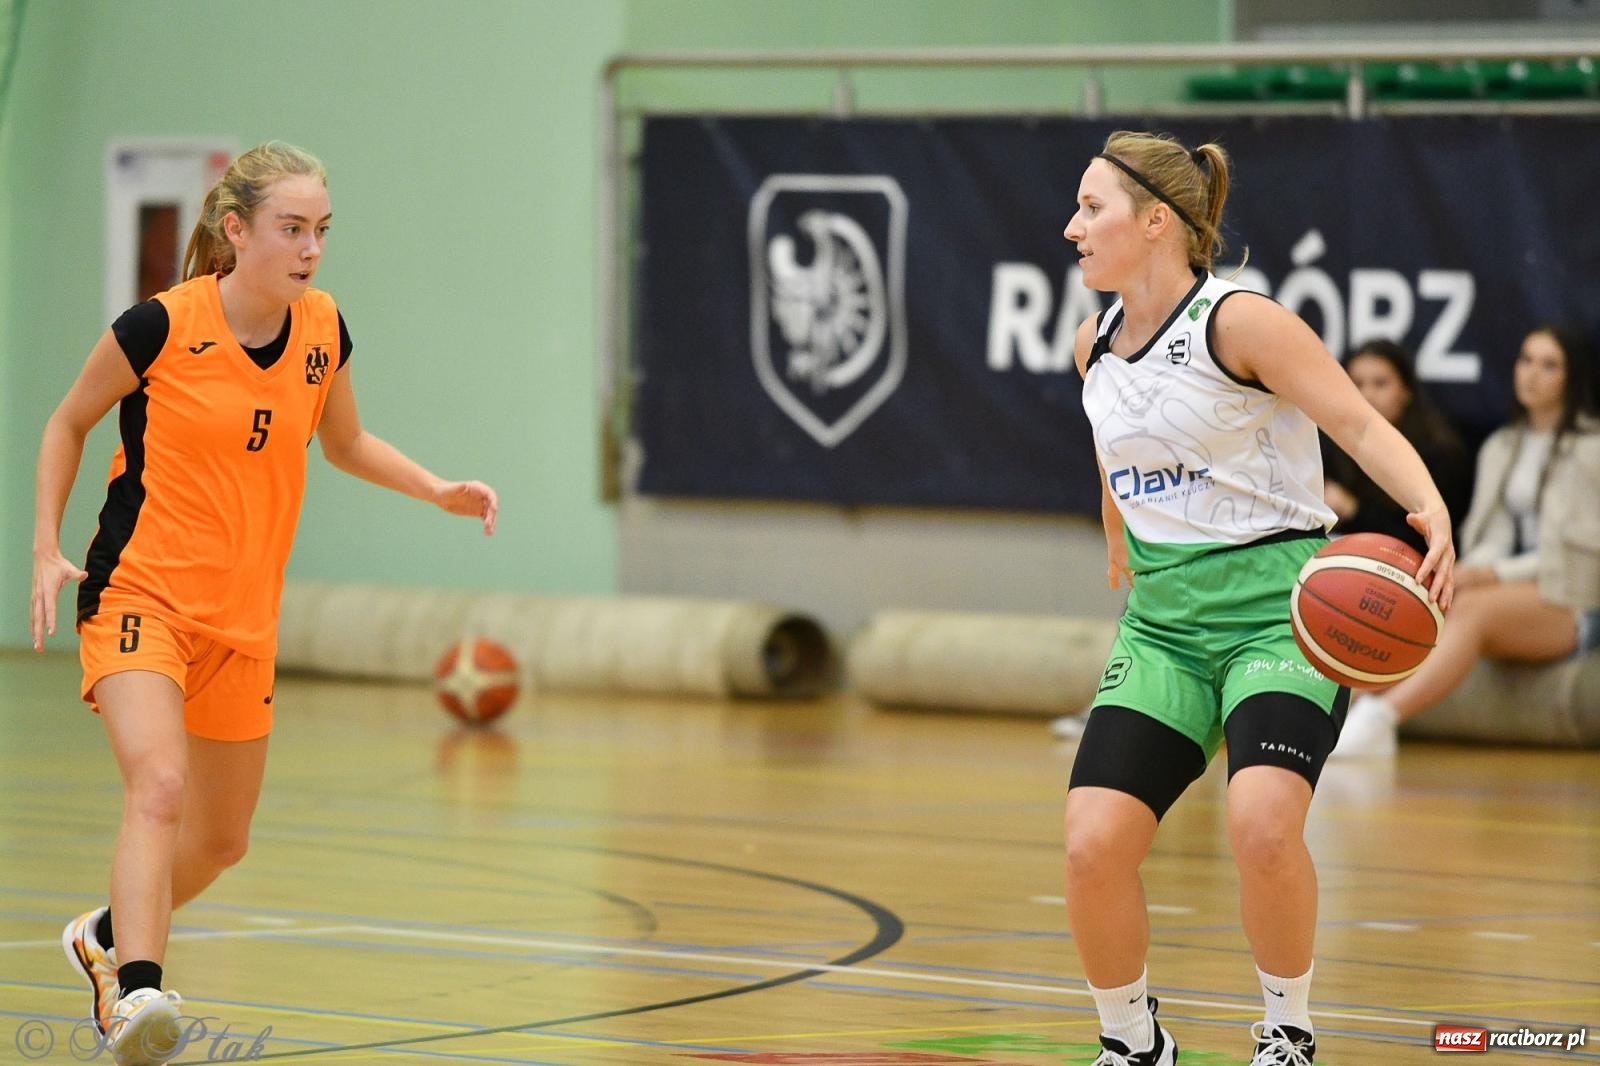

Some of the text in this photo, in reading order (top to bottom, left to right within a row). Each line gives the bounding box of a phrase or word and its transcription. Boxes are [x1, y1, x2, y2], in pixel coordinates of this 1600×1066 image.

[987, 228, 1481, 383] RAÓRZ
[246, 409, 272, 451] 5
[1359, 595, 1393, 621] FIBA
[119, 614, 141, 653] 5
[1325, 624, 1393, 663] molten
[1260, 742, 1312, 764] TARMAK
